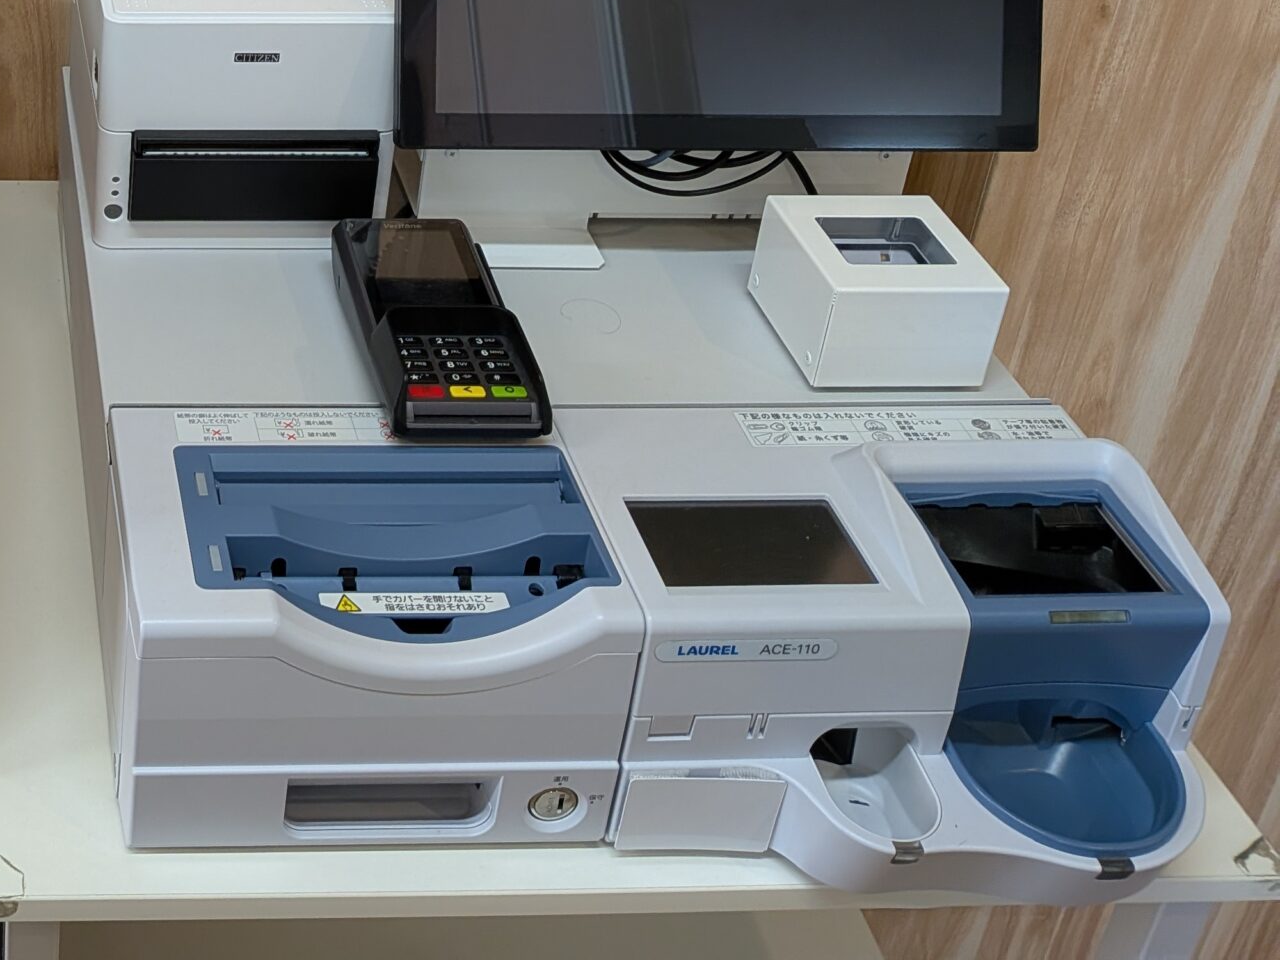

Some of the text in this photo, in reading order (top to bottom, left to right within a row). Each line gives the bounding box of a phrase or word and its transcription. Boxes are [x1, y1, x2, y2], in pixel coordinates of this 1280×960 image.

[235, 53, 280, 62] CITIZEN
[738, 412, 917, 420] 下記の様なものは入れないでください
[372, 595, 494, 603] 手でカバーを開けないこと
[385, 603, 486, 612] 指をはさむおそれあり
[677, 644, 820, 656] LAUREL ACE-110
